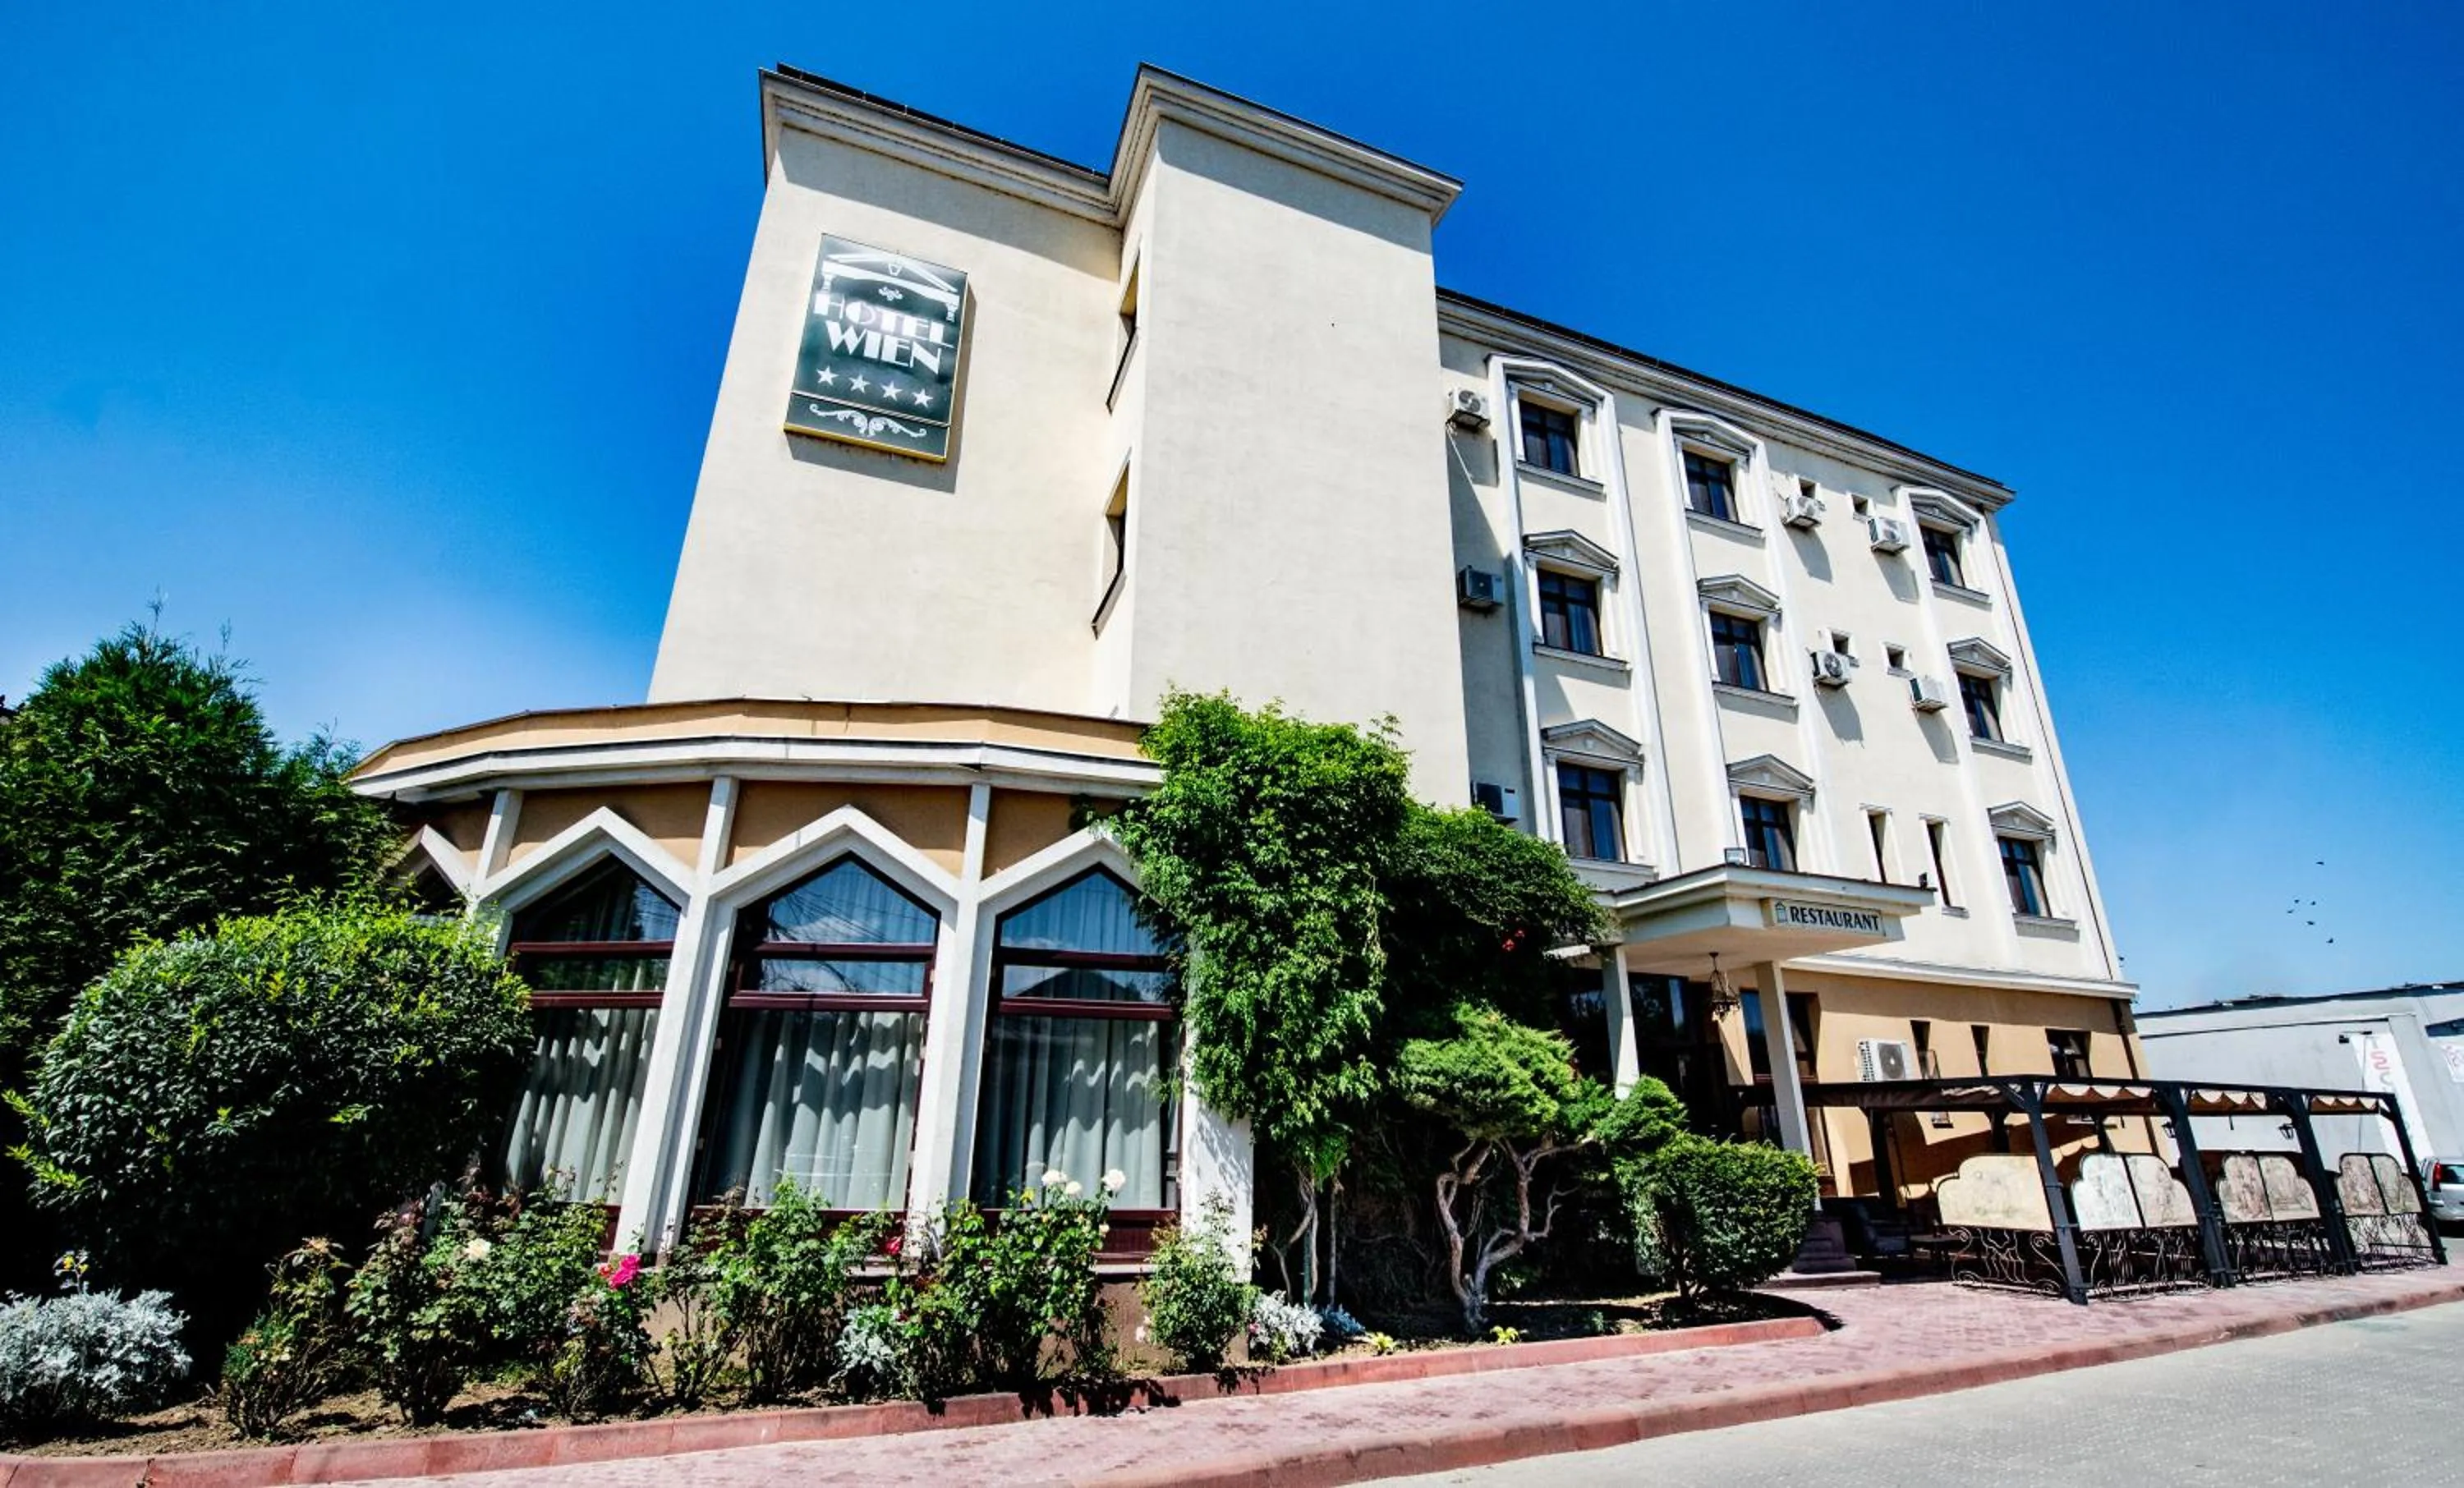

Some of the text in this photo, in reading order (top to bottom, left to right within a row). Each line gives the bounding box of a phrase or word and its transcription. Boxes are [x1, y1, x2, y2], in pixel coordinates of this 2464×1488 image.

[814, 293, 954, 348] HOTEL
[825, 319, 942, 375] WIEN
[1790, 906, 1879, 931] RESTAURANT
